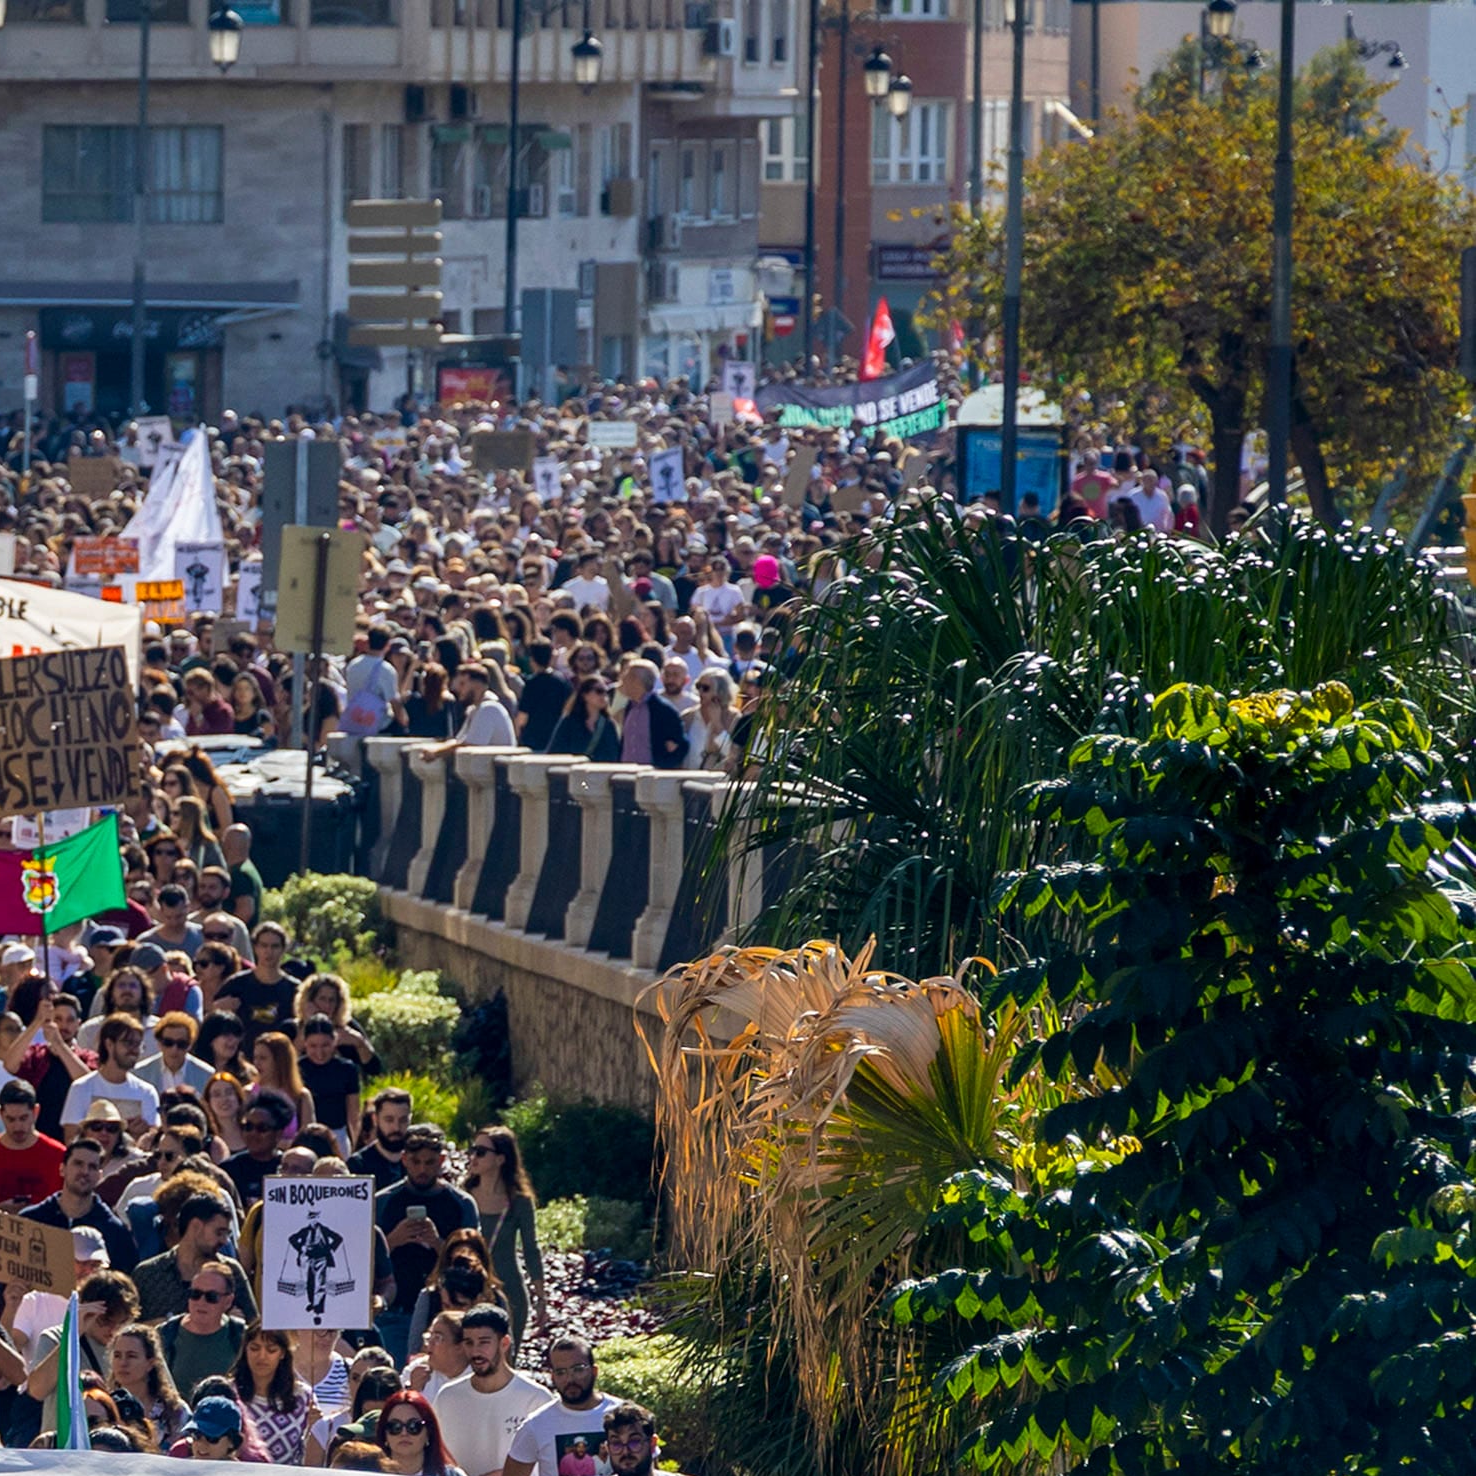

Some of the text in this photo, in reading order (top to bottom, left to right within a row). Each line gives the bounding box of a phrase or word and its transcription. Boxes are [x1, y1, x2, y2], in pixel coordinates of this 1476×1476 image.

[43, 649, 126, 696] SUIZO
[25, 692, 131, 748] CHINO
[3, 752, 49, 810] SE
[66, 745, 139, 802] VENDE
[268, 1181, 368, 1206] SIN BOQUERONES
[8, 1216, 24, 1236] TE
[8, 1260, 52, 1287] GUIRIS
